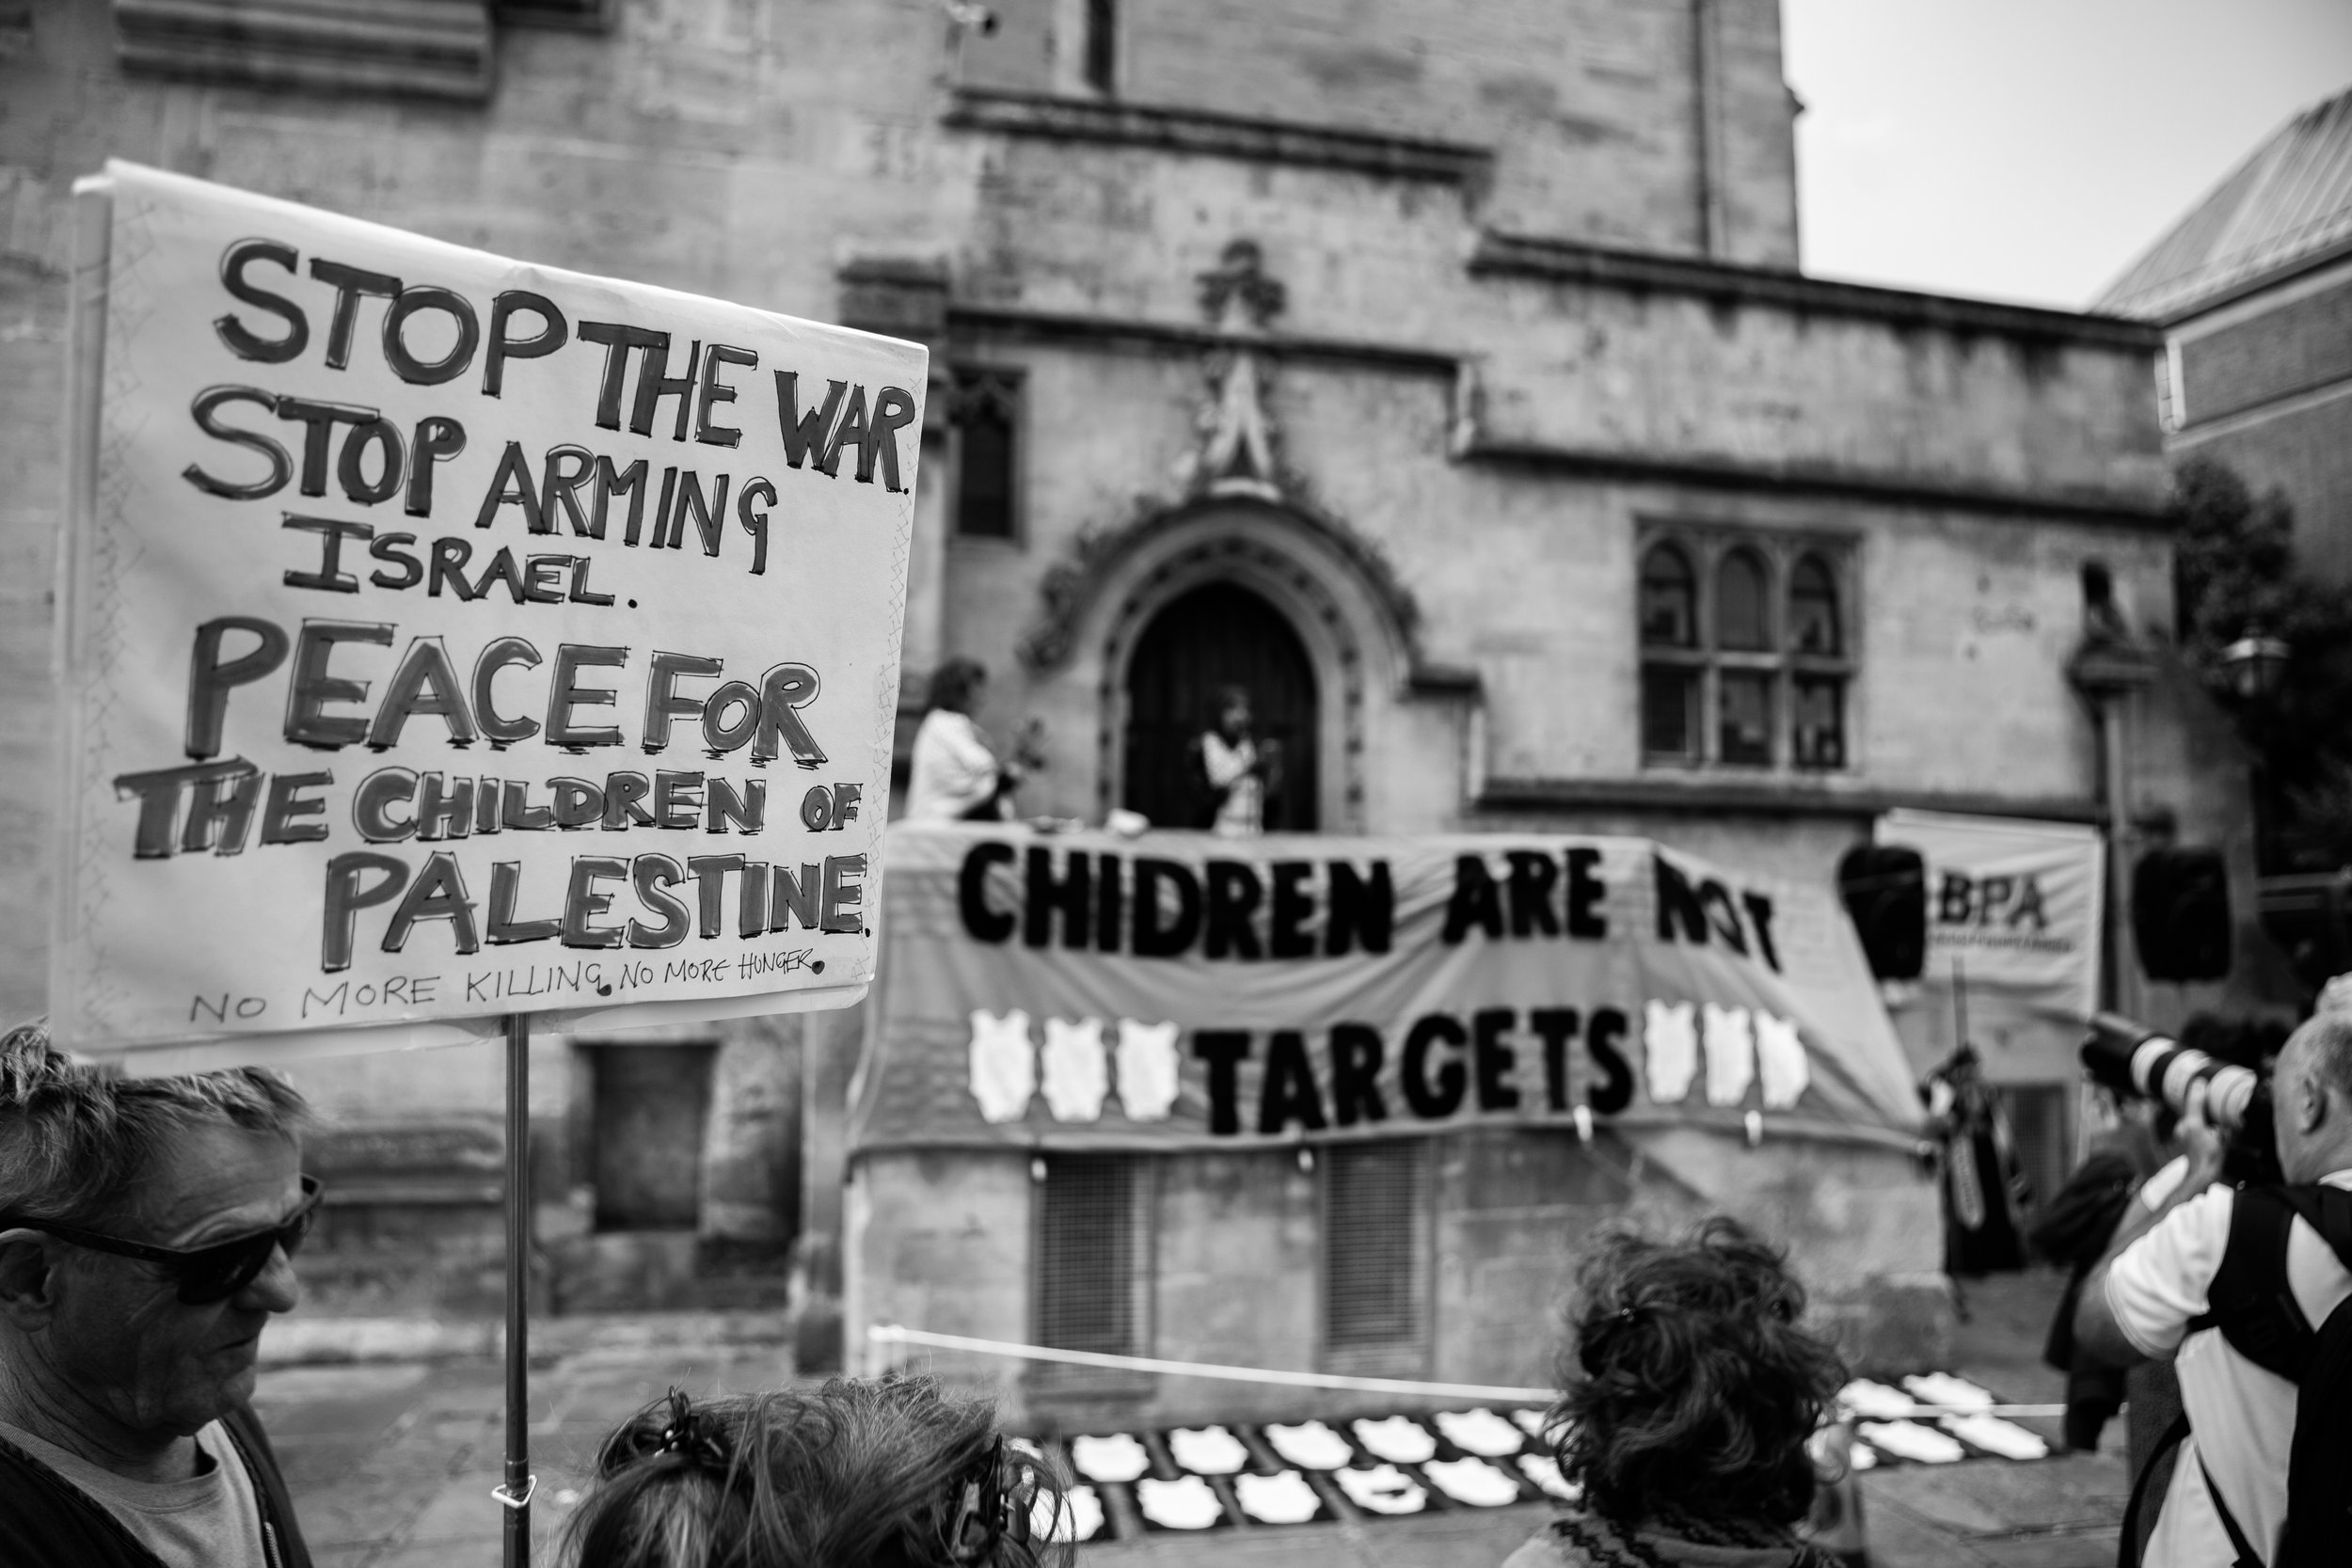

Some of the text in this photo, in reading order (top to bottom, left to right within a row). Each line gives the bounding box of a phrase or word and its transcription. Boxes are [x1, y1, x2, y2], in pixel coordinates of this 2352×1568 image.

[213, 237, 916, 495] STOP THE WAR.
[181, 383, 778, 576] STOP ARMING
[184, 616, 828, 768] PEACE FOR
[112, 755, 864, 860] THE CHILDREN OF
[958, 840, 1781, 973] CHIDREN ARE NOT
[1938, 872, 2049, 930] BPA
[191, 993, 267, 1022] NO
[302, 976, 441, 1019] MORE
[618, 962, 656, 990] NO
[663, 958, 730, 983] MORE
[1191, 1006, 1634, 1136] TARGETS
